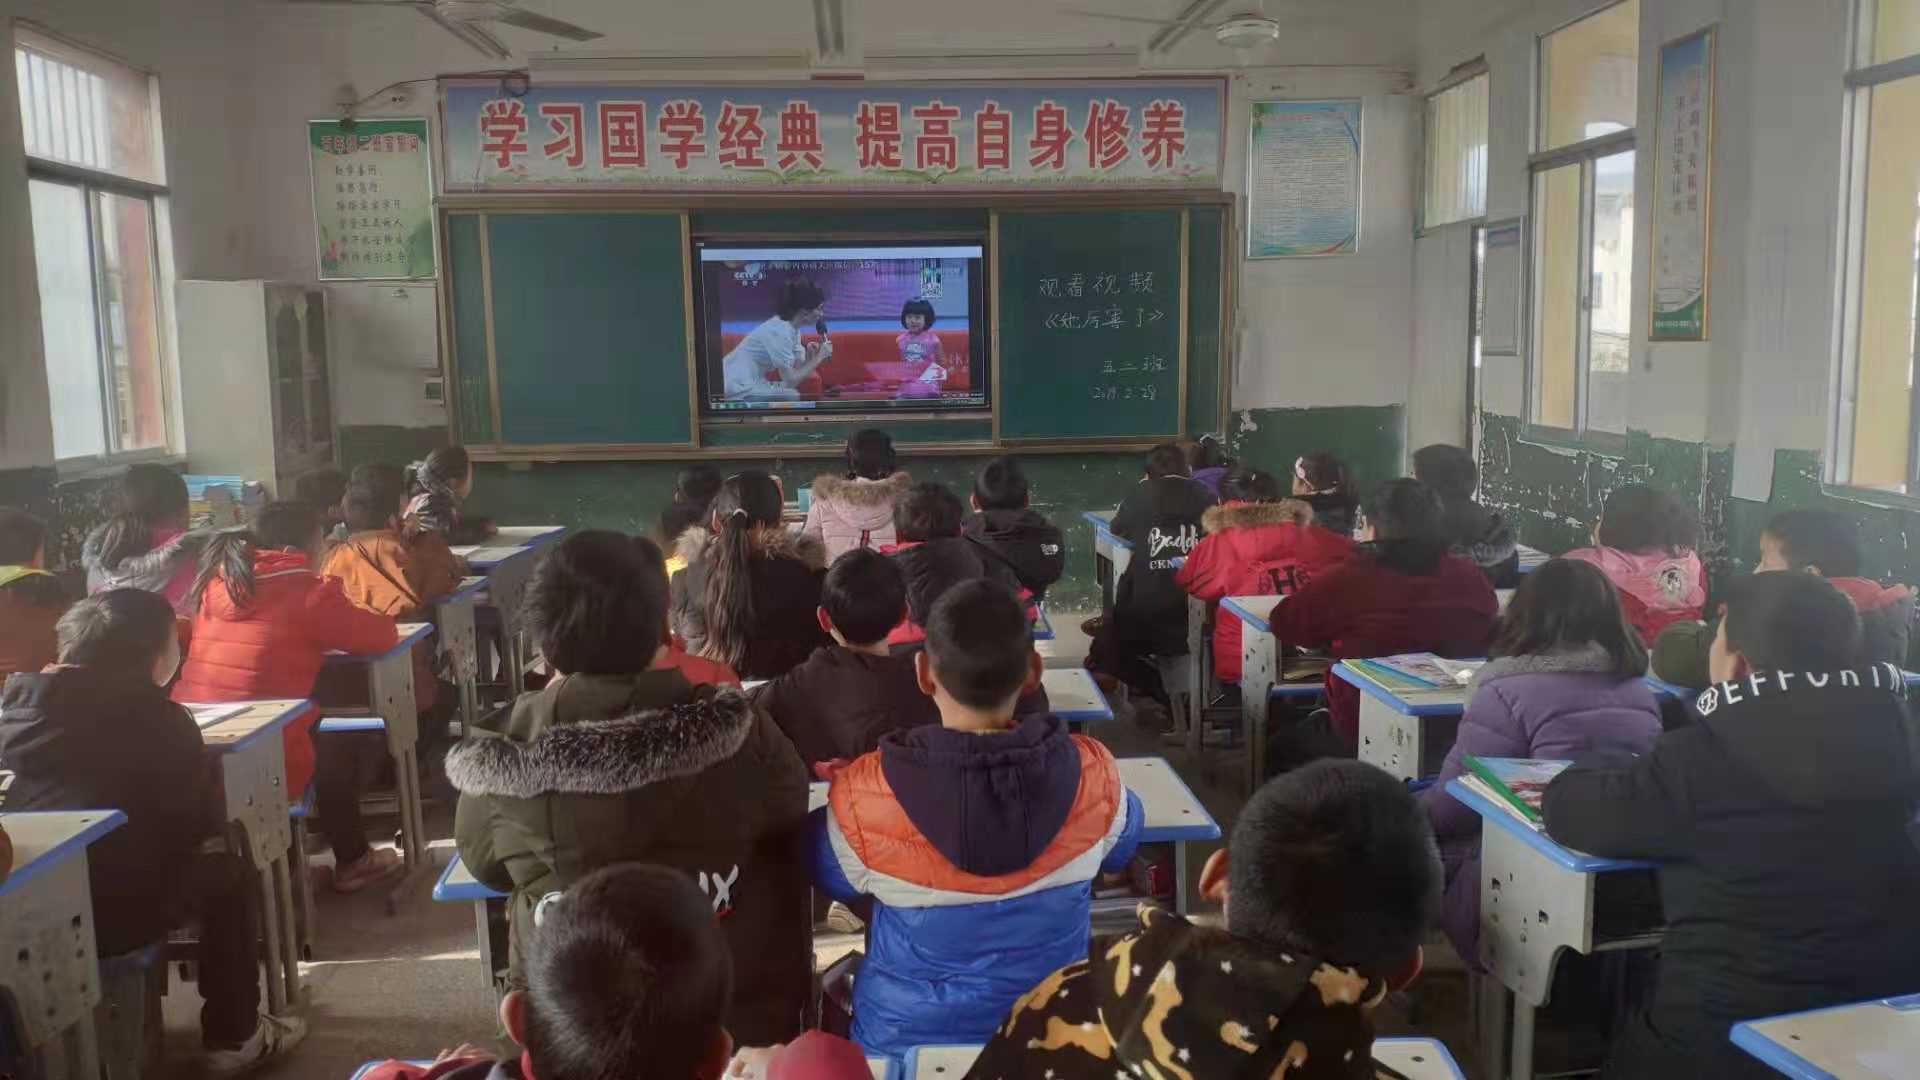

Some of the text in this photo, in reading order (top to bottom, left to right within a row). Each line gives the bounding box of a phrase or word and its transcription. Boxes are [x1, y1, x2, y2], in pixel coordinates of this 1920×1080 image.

[480, 101, 1187, 169] 学习国学经典 提高自身修养
[1039, 271, 1154, 297] 观看视频
[1103, 355, 1166, 373] 五二班
